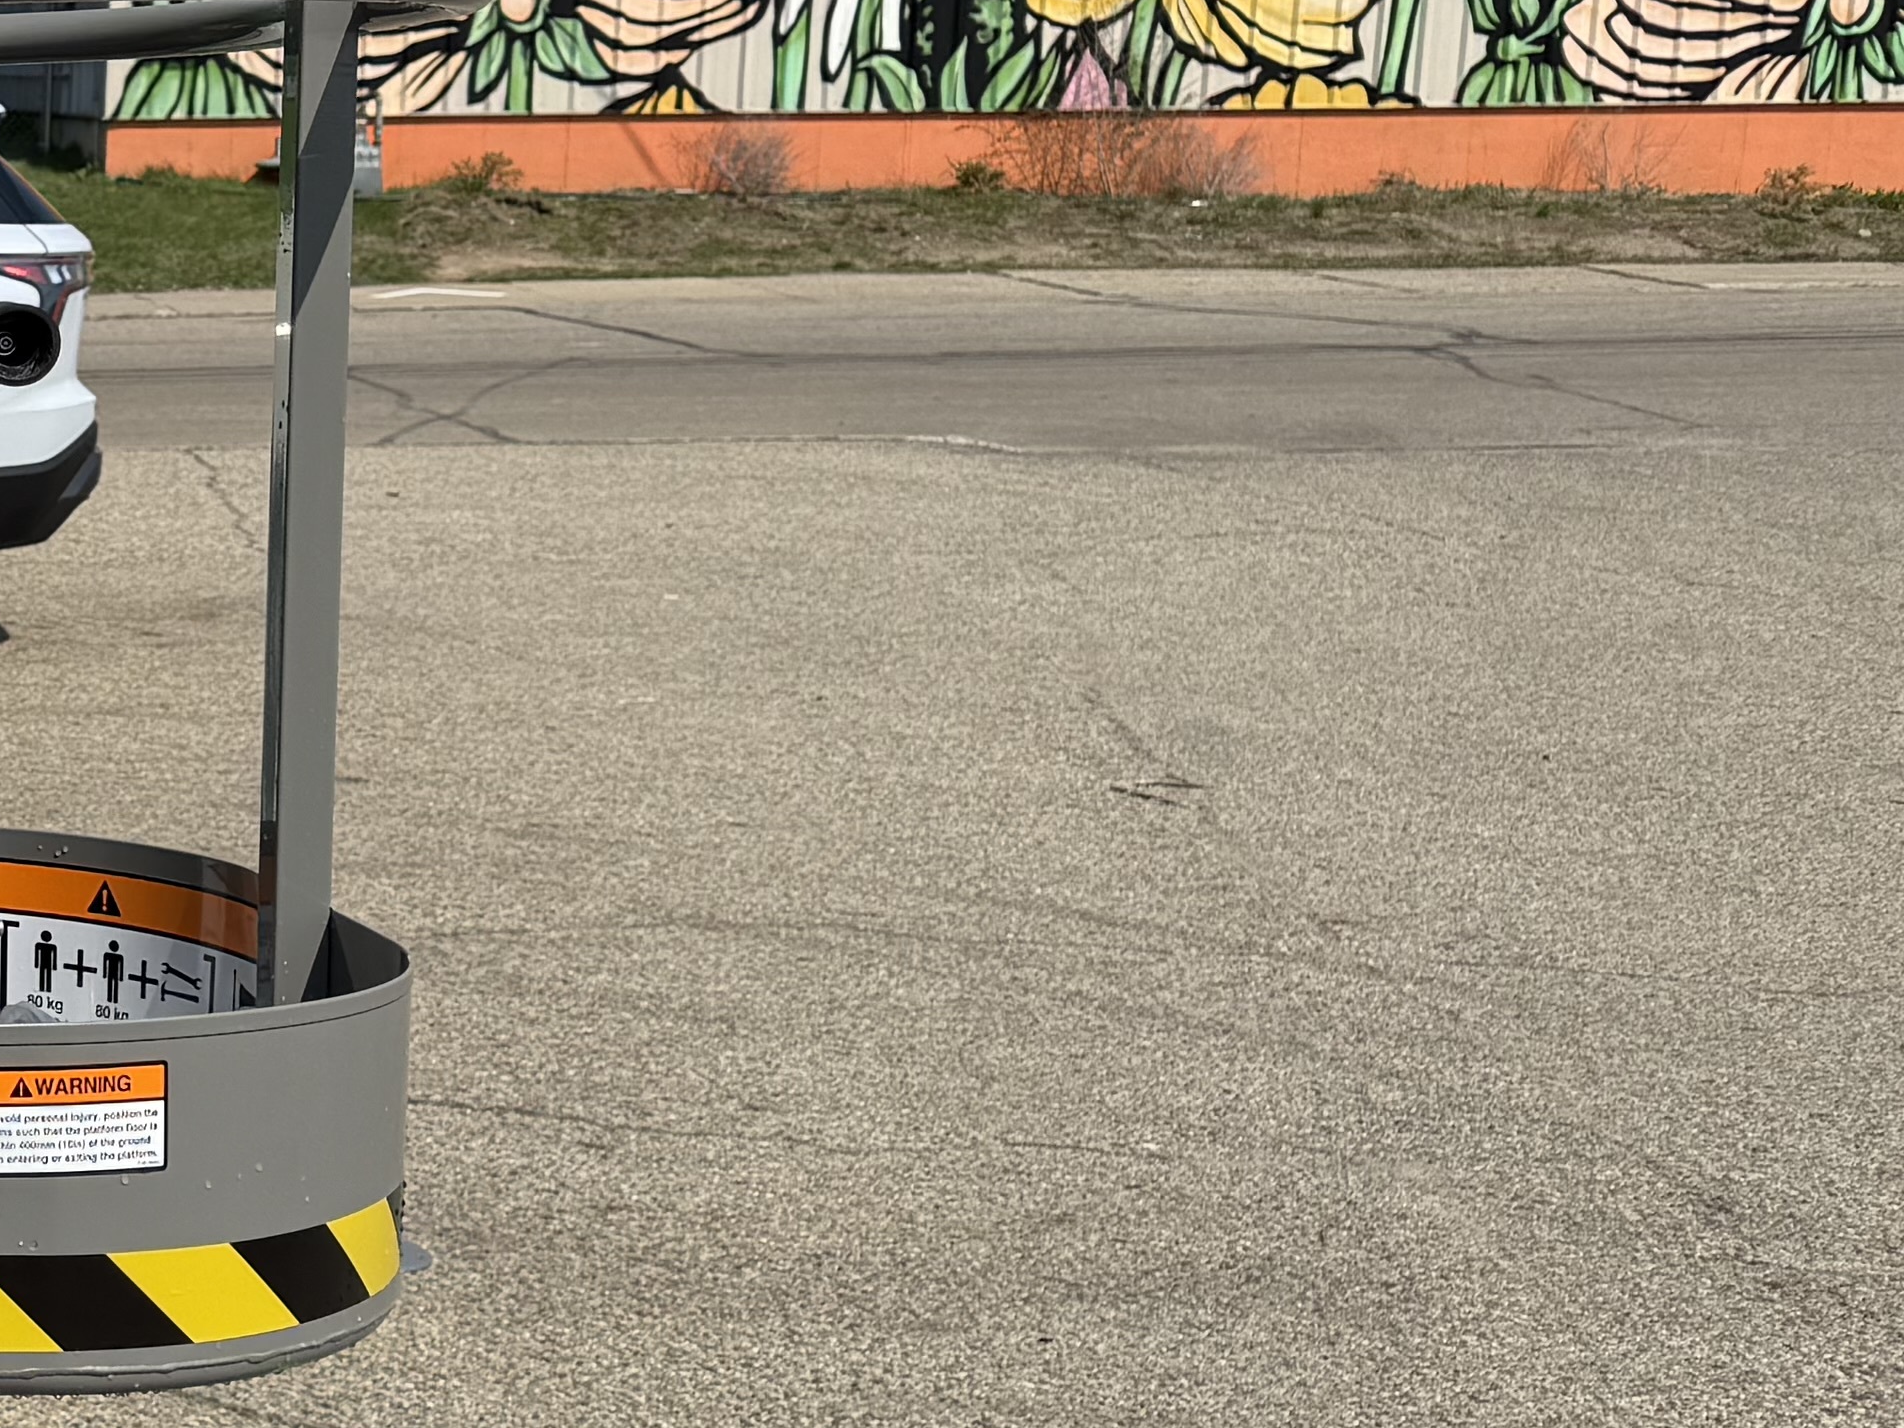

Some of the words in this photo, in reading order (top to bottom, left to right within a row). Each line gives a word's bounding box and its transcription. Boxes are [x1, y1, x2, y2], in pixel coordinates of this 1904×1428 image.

[47, 996, 63, 1014] kg
[95, 1004, 110, 1019] 80
[34, 1074, 132, 1096] WARNING
[16, 1128, 40, 1136] such
